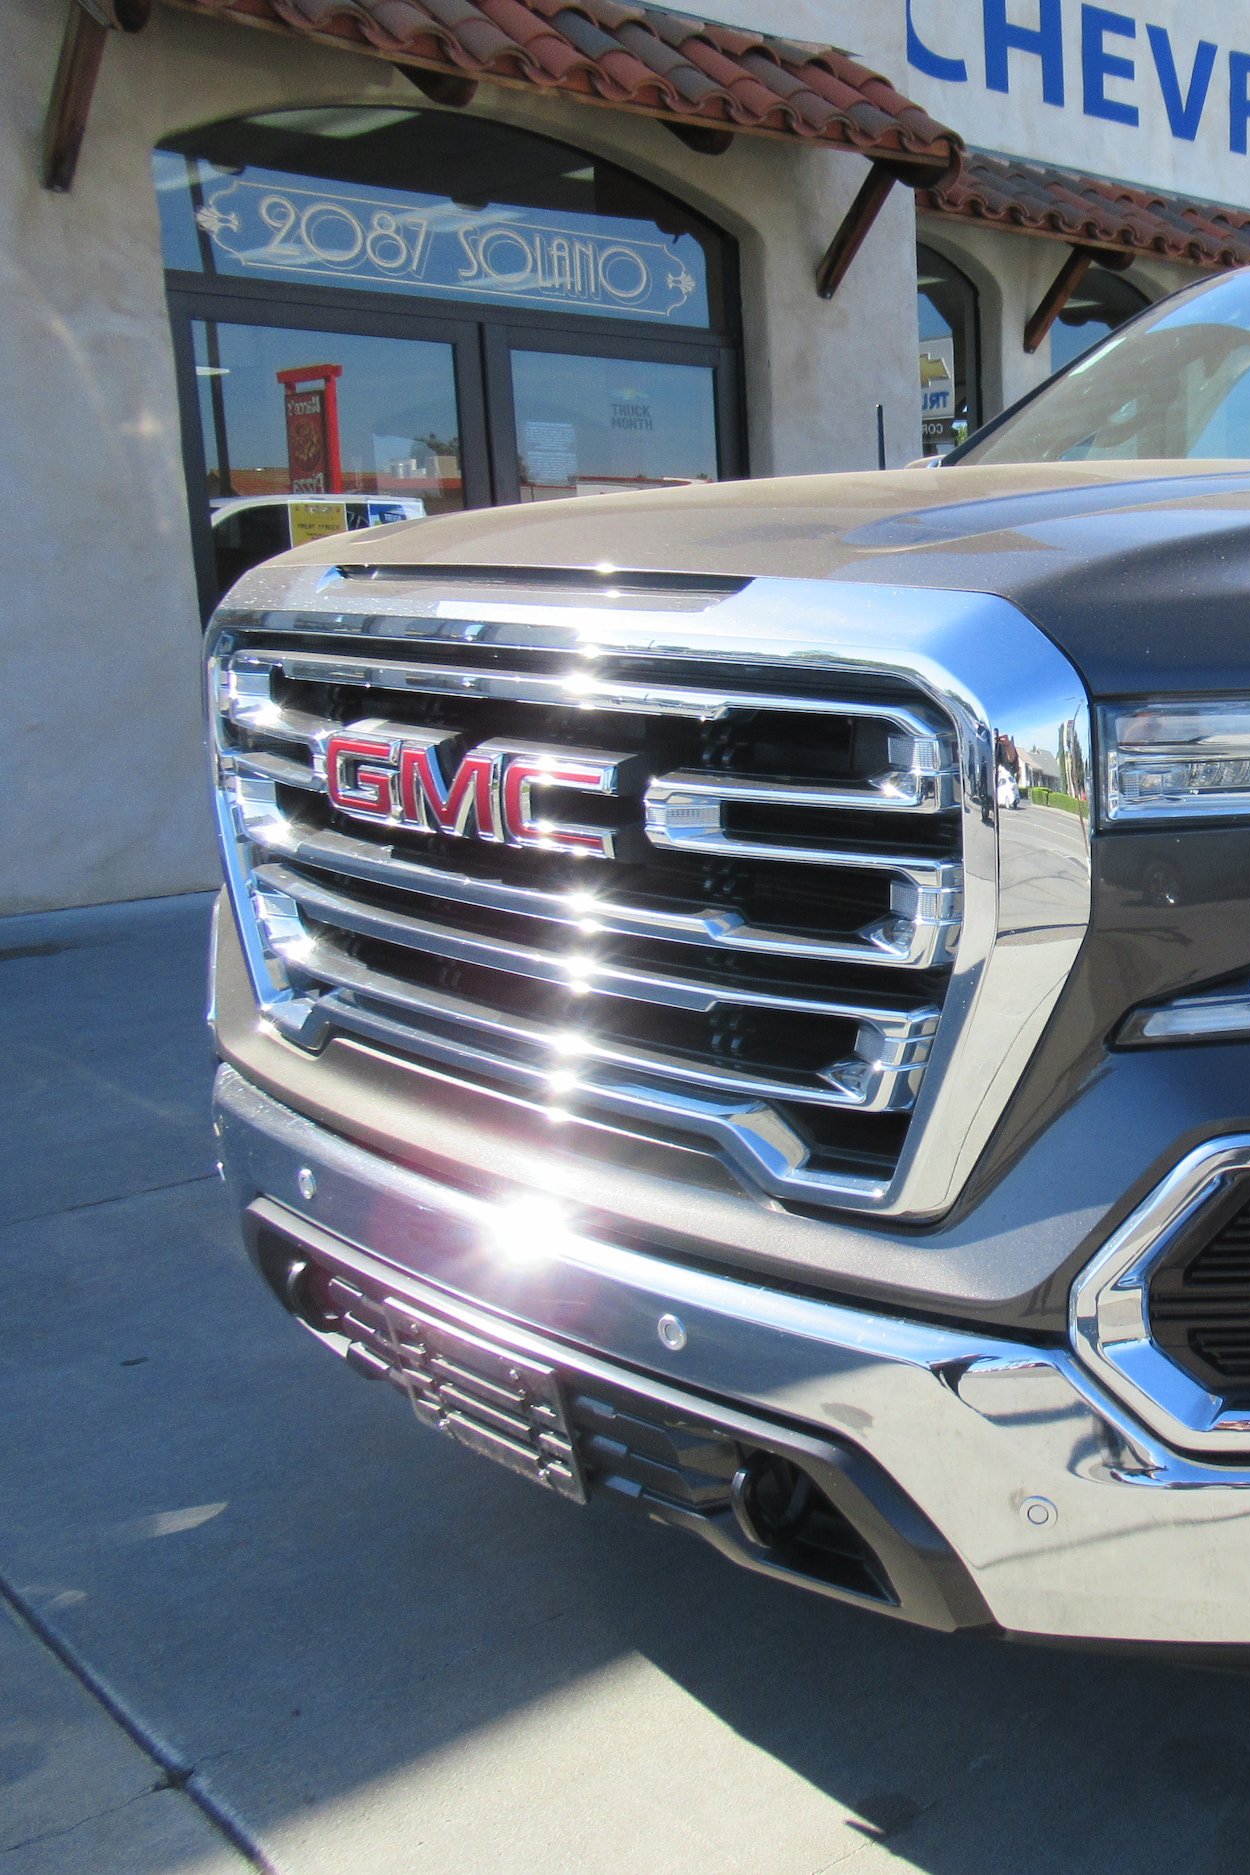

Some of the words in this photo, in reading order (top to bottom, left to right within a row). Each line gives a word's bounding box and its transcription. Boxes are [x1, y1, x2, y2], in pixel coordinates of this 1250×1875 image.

[258, 195, 432, 277] 2087
[457, 223, 652, 303] SOLANO
[611, 403, 651, 418] TRUCK
[611, 416, 653, 431] MONTH
[326, 734, 620, 860] GMC
